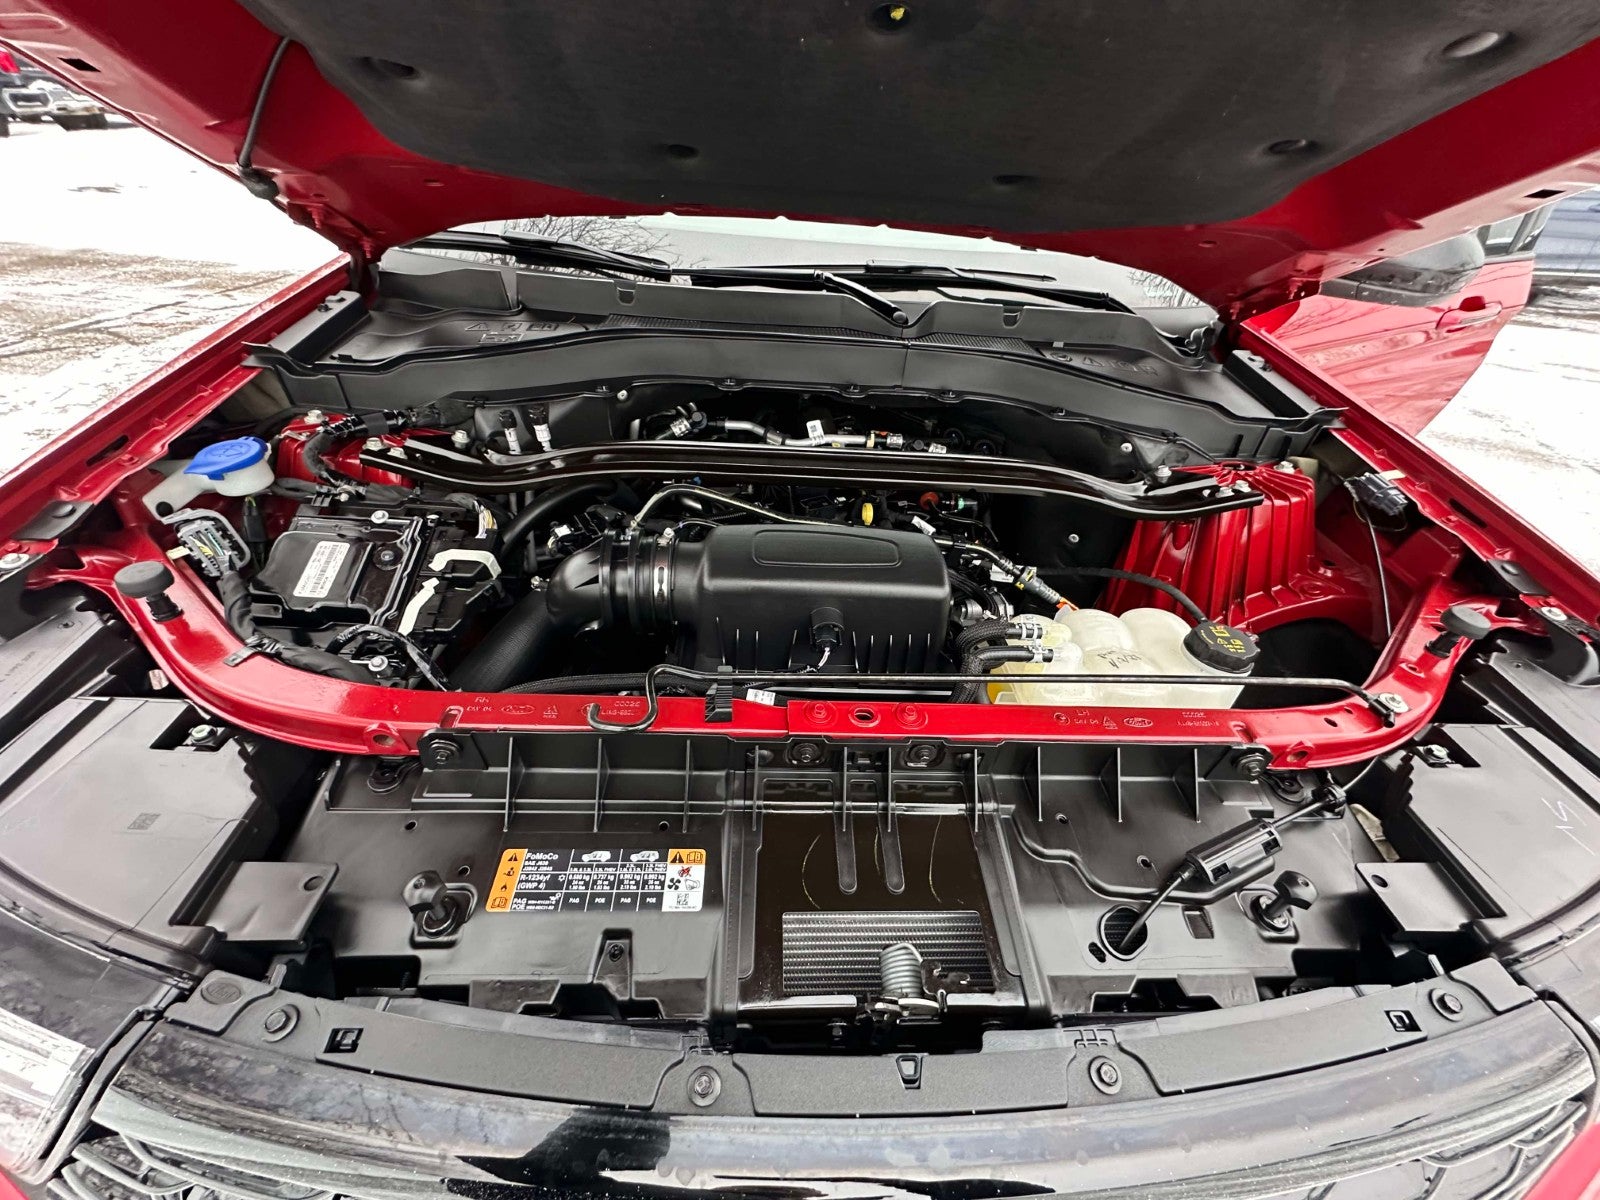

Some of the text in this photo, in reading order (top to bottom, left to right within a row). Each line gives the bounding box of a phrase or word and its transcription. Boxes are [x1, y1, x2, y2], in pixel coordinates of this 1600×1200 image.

[520, 874, 551, 882] R-1234yf
[517, 882, 546, 891] (GWP 4)
